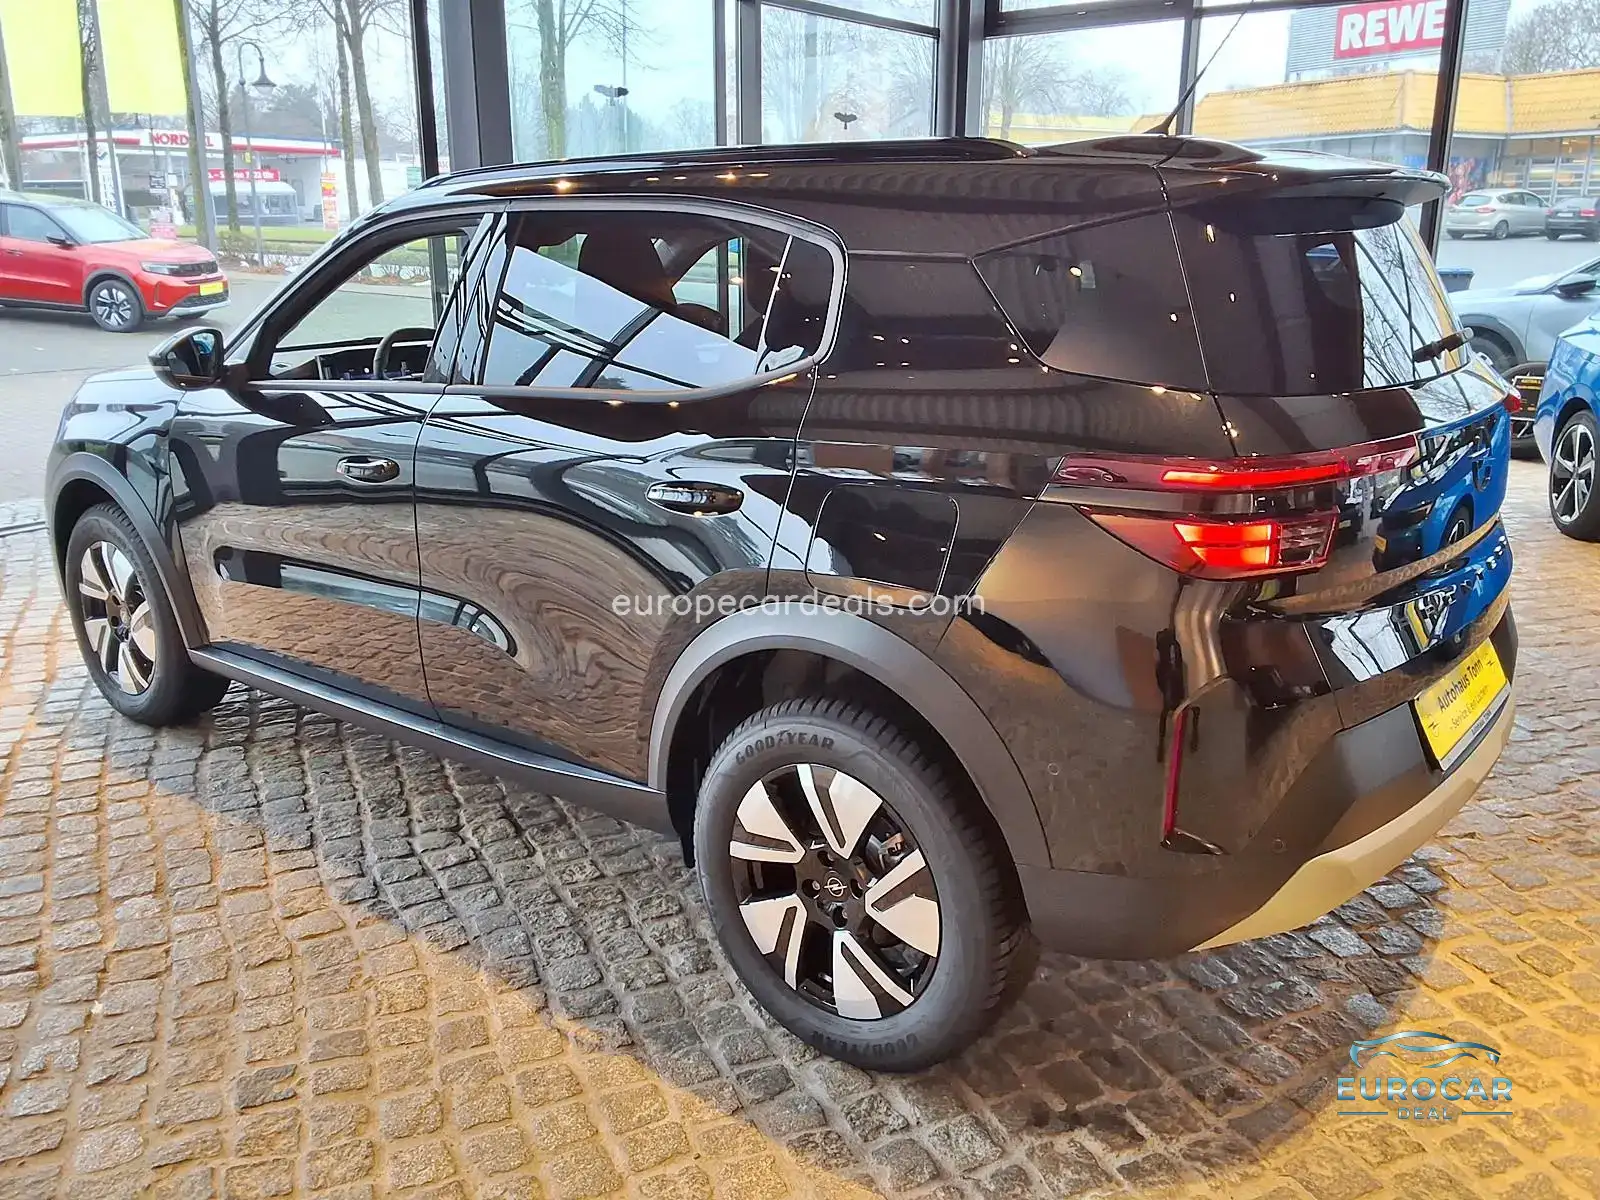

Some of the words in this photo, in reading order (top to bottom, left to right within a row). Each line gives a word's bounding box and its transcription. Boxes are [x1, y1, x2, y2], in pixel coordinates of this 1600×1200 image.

[1340, 1, 1447, 51] REWE
[150, 131, 214, 147] NORDL
[1436, 674, 1471, 713] Autohaus
[1466, 659, 1484, 681] Tonn
[736, 730, 835, 765] GOODYEAR
